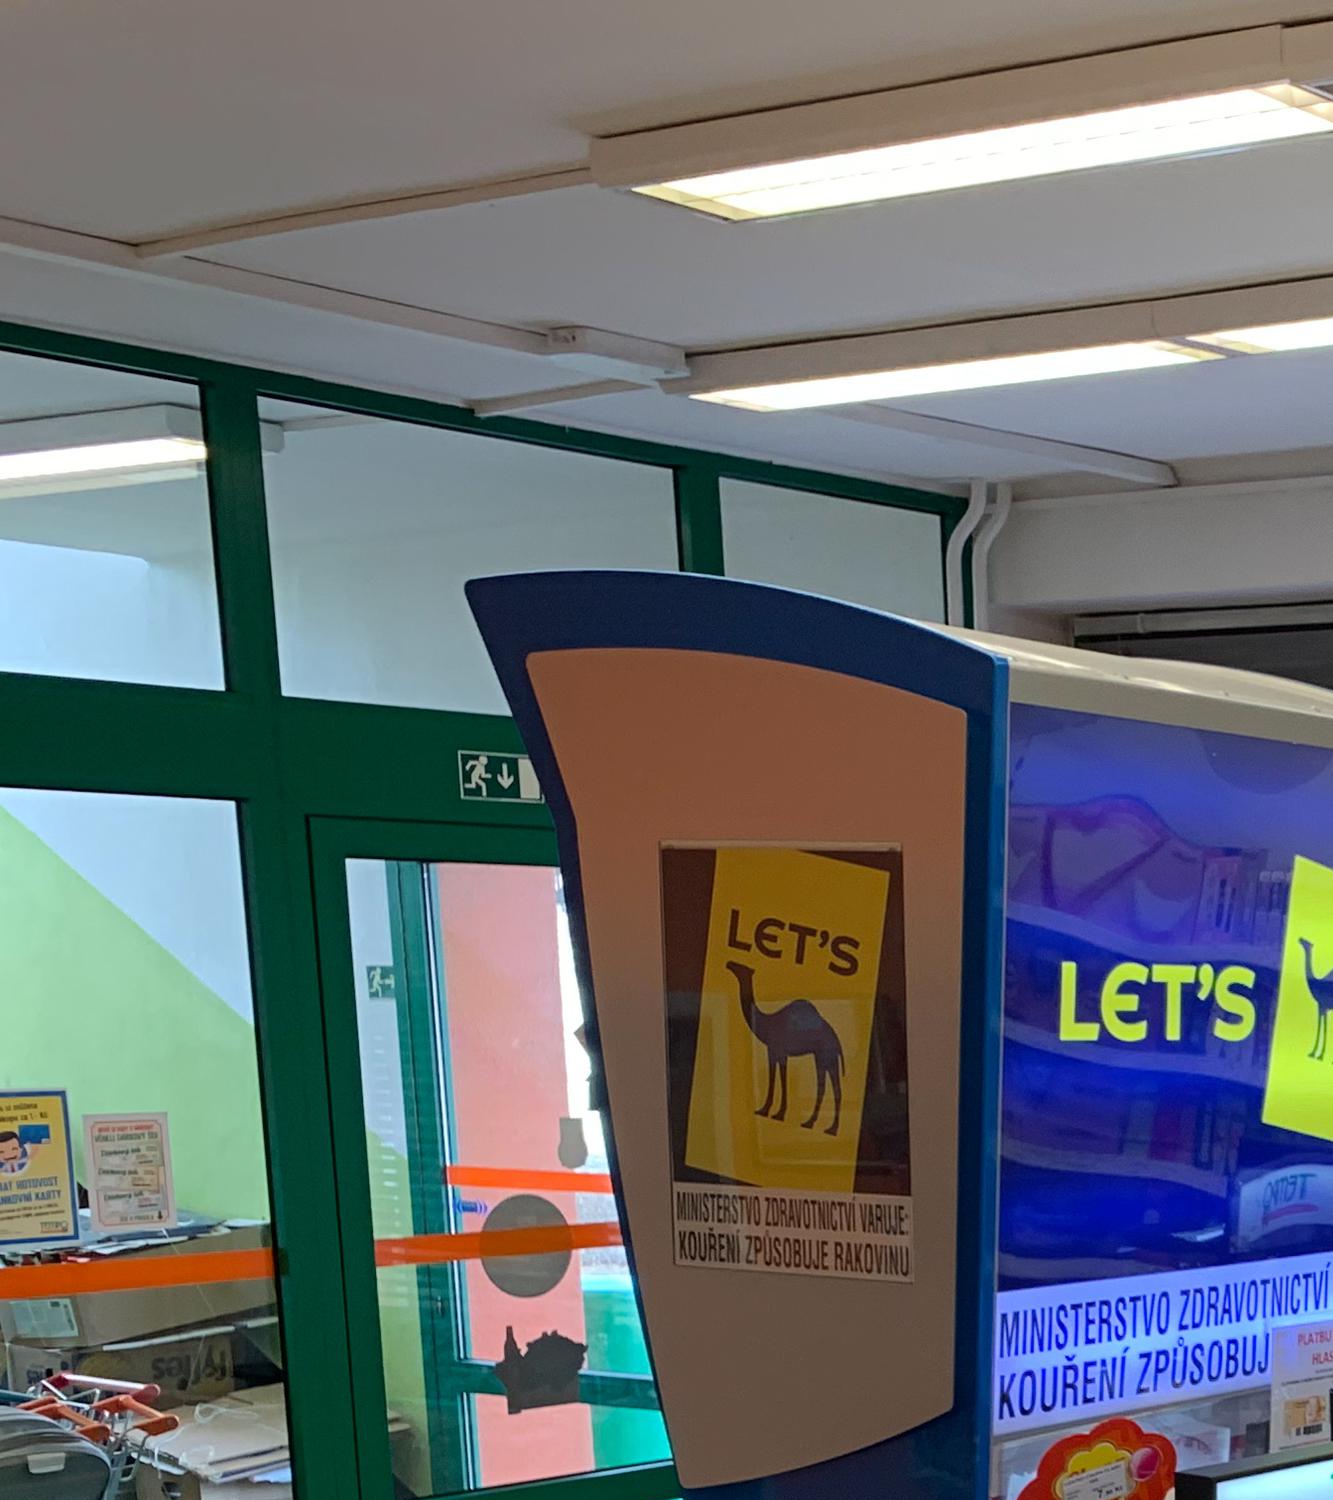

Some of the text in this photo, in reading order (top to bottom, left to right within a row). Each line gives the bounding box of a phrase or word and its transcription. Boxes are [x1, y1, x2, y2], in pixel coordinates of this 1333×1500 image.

[726, 909, 860, 976] LET'S
[1059, 960, 1256, 1043] LET'S
[677, 1192, 909, 1237] MINISTERSTVO ZDRAVOTNICTVÍ VARUJE:
[679, 1229, 910, 1278] KOUŘENÍ ZPŮSOBUJE RAKOVINU
[1000, 1291, 1170, 1358] MINISTERSTVO
[1178, 1262, 1331, 1331] ZDRAVOTNICTVÍ
[1298, 1328, 1332, 1348] PLATBU
[998, 1333, 1270, 1421] KOUŘENÍ ZPŮSOBUJ
